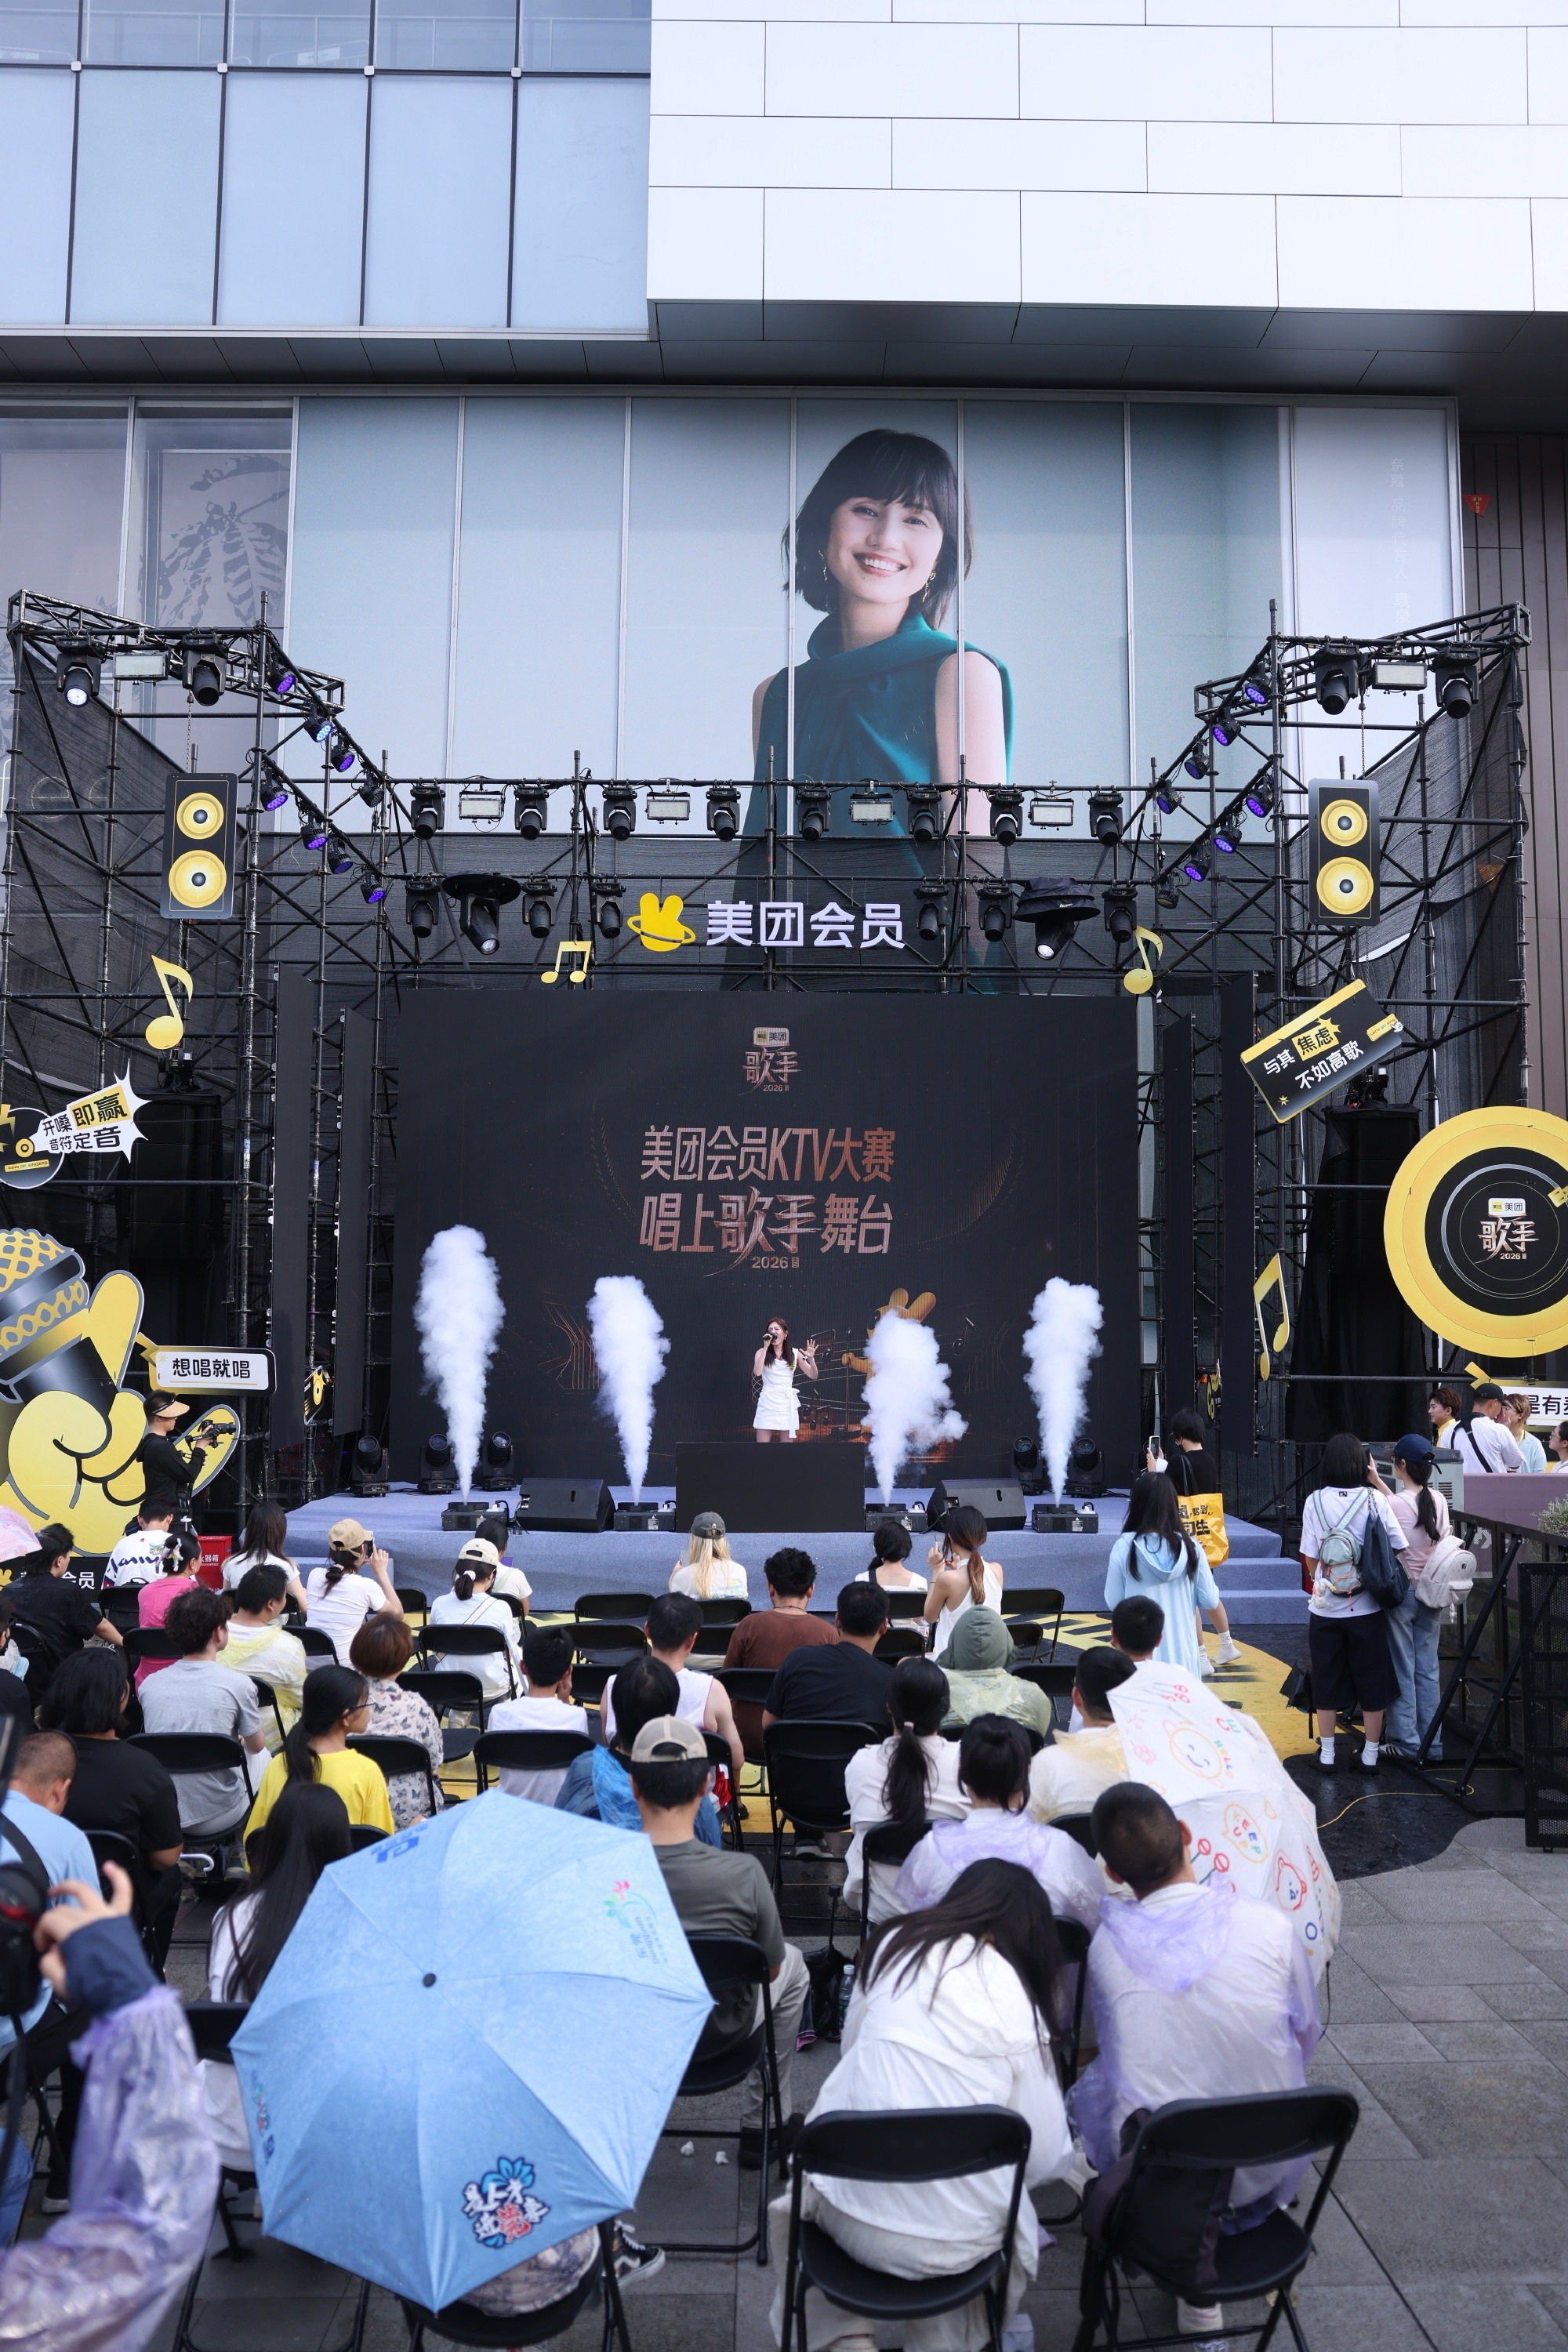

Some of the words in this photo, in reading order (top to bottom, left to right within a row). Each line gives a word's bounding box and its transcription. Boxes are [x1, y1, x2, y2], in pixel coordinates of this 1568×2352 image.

[1392, 498, 1409, 579] 品牌代言人
[1393, 592, 1410, 624] 袁泉
[706, 900, 906, 949] 美团会员
[768, 1032, 787, 1041] 美团
[1263, 1026, 1334, 1075] 与其焦虑
[739, 1047, 801, 1093] 歌手
[1294, 1040, 1364, 1091] 不如高歌
[42, 1092, 129, 1137] 开嗓即赢
[49, 1126, 122, 1151] 音符定音
[641, 1124, 896, 1182] 美团会员KTV大赛
[638, 1186, 893, 1257] 唱上歌手舞台
[1504, 1203, 1523, 1211] 美团
[1475, 1216, 1540, 1260] 歌手
[752, 1256, 789, 1269] 2026
[172, 1357, 251, 1379] 想唱就唱
[1232, 1809, 1262, 1855] KEEP
